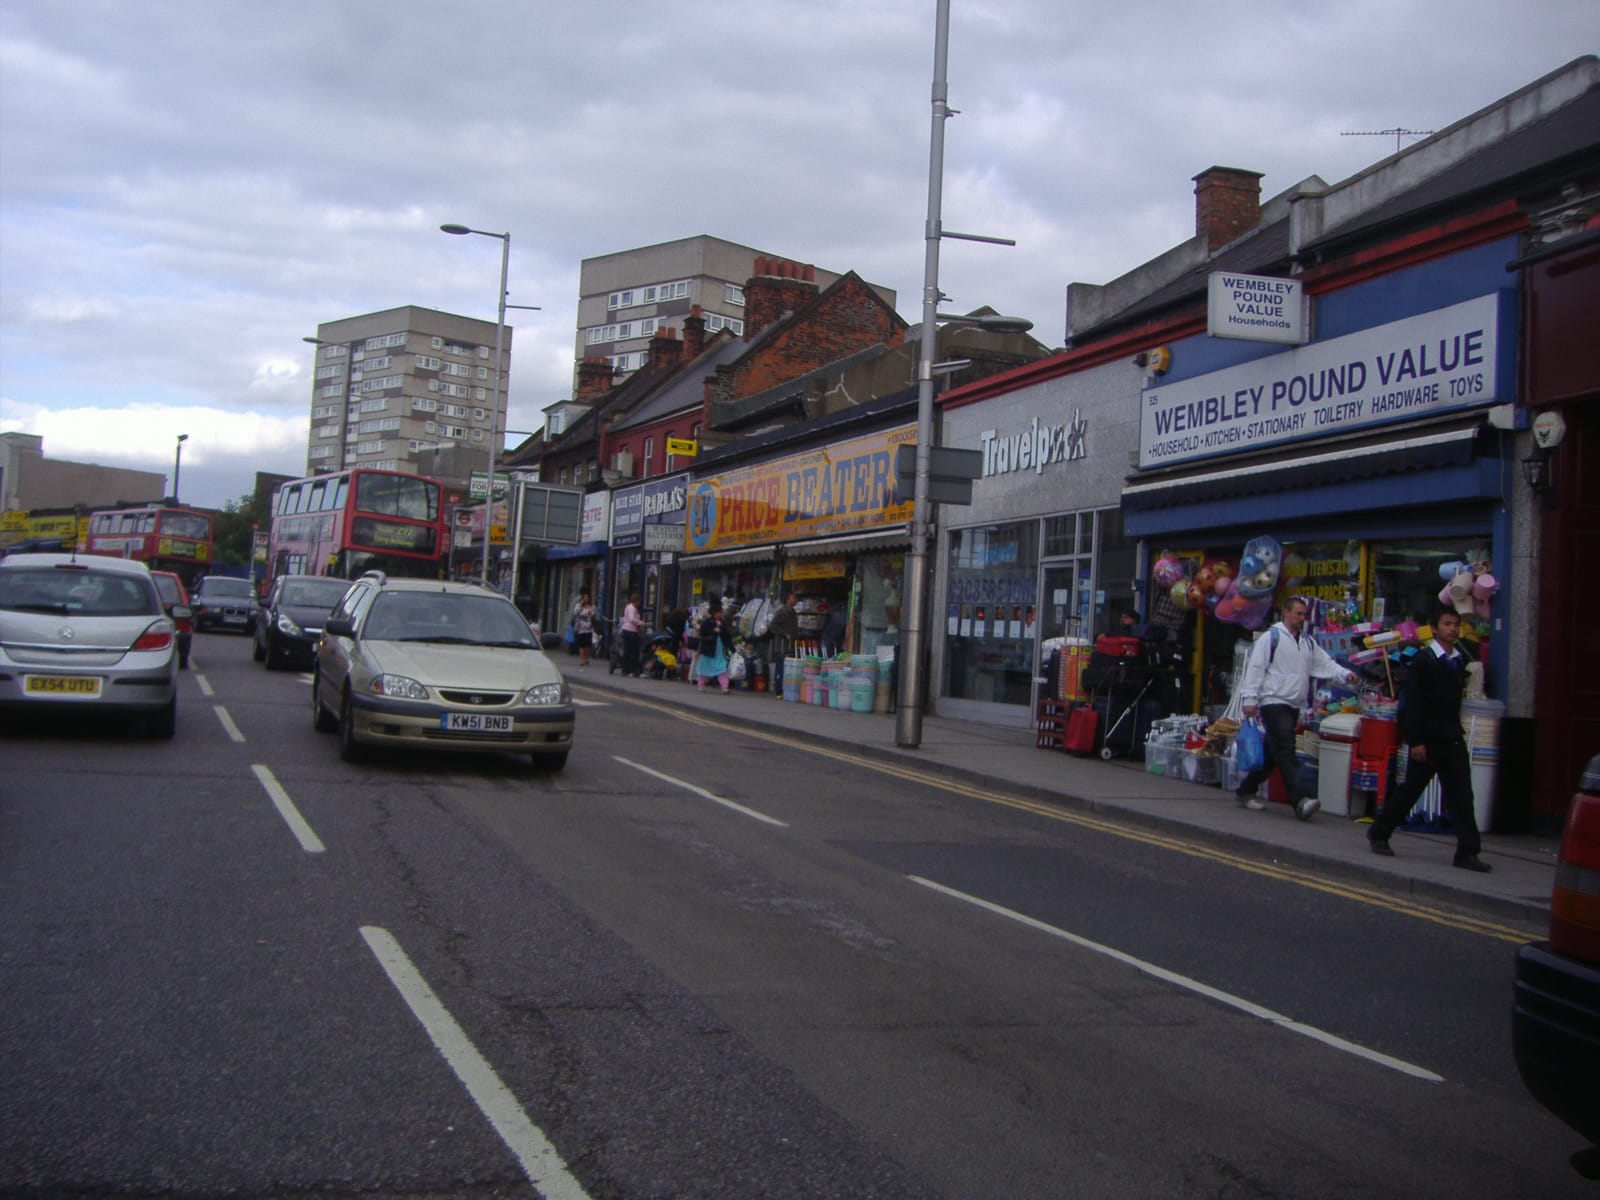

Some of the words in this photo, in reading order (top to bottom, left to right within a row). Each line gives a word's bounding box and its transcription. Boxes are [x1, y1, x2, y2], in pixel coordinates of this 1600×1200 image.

[1222, 277, 1294, 294] WEMBLEY
[1233, 291, 1283, 305] POUND
[1236, 303, 1283, 317] VALUE
[1228, 315, 1291, 328] Households
[1155, 385, 1264, 436] WEMBLEY
[1271, 360, 1367, 411] POUND
[1376, 329, 1483, 386] VALUE
[1205, 428, 1241, 448] KITCHEN
[1247, 412, 1306, 439] STATIONARY
[1313, 399, 1364, 426] TOILETRY
[1371, 383, 1439, 414] HARDWARE
[1449, 373, 1483, 398] TOYS
[717, 477, 780, 534] PRICE
